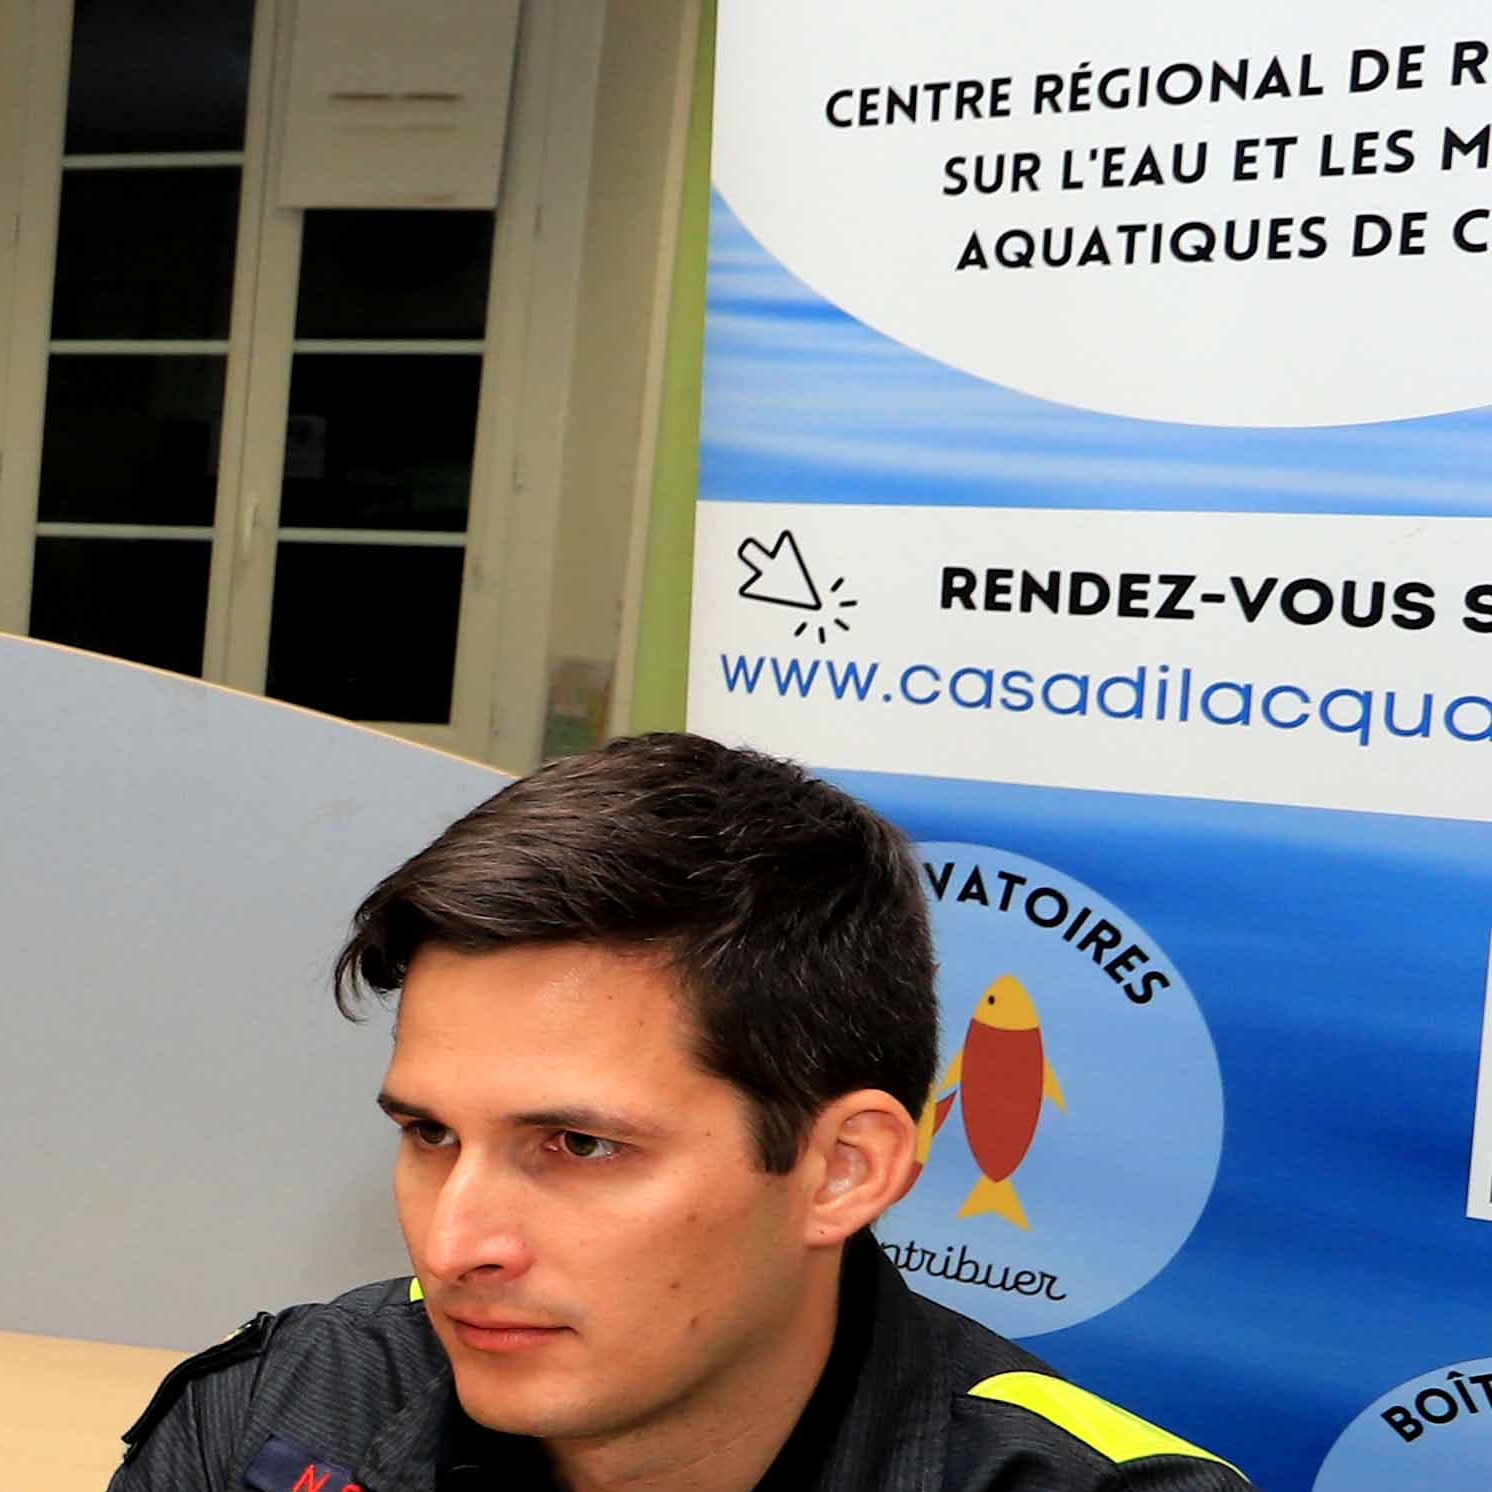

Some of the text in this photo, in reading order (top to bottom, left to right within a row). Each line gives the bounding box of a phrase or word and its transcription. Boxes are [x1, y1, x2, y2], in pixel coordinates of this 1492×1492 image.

[825, 76, 1012, 128] CENTRE
[1033, 52, 1324, 114] RÉGIONAL
[1349, 44, 1425, 94] DE
[942, 150, 1041, 197] SUR
[1060, 140, 1208, 190] L'EAU
[1232, 135, 1299, 182] ET
[1320, 127, 1414, 178] LES
[955, 214, 1327, 272] AQUATIQUES
[1352, 210, 1428, 258] DE
[940, 566, 1436, 631] RENDEZ-VOUS
